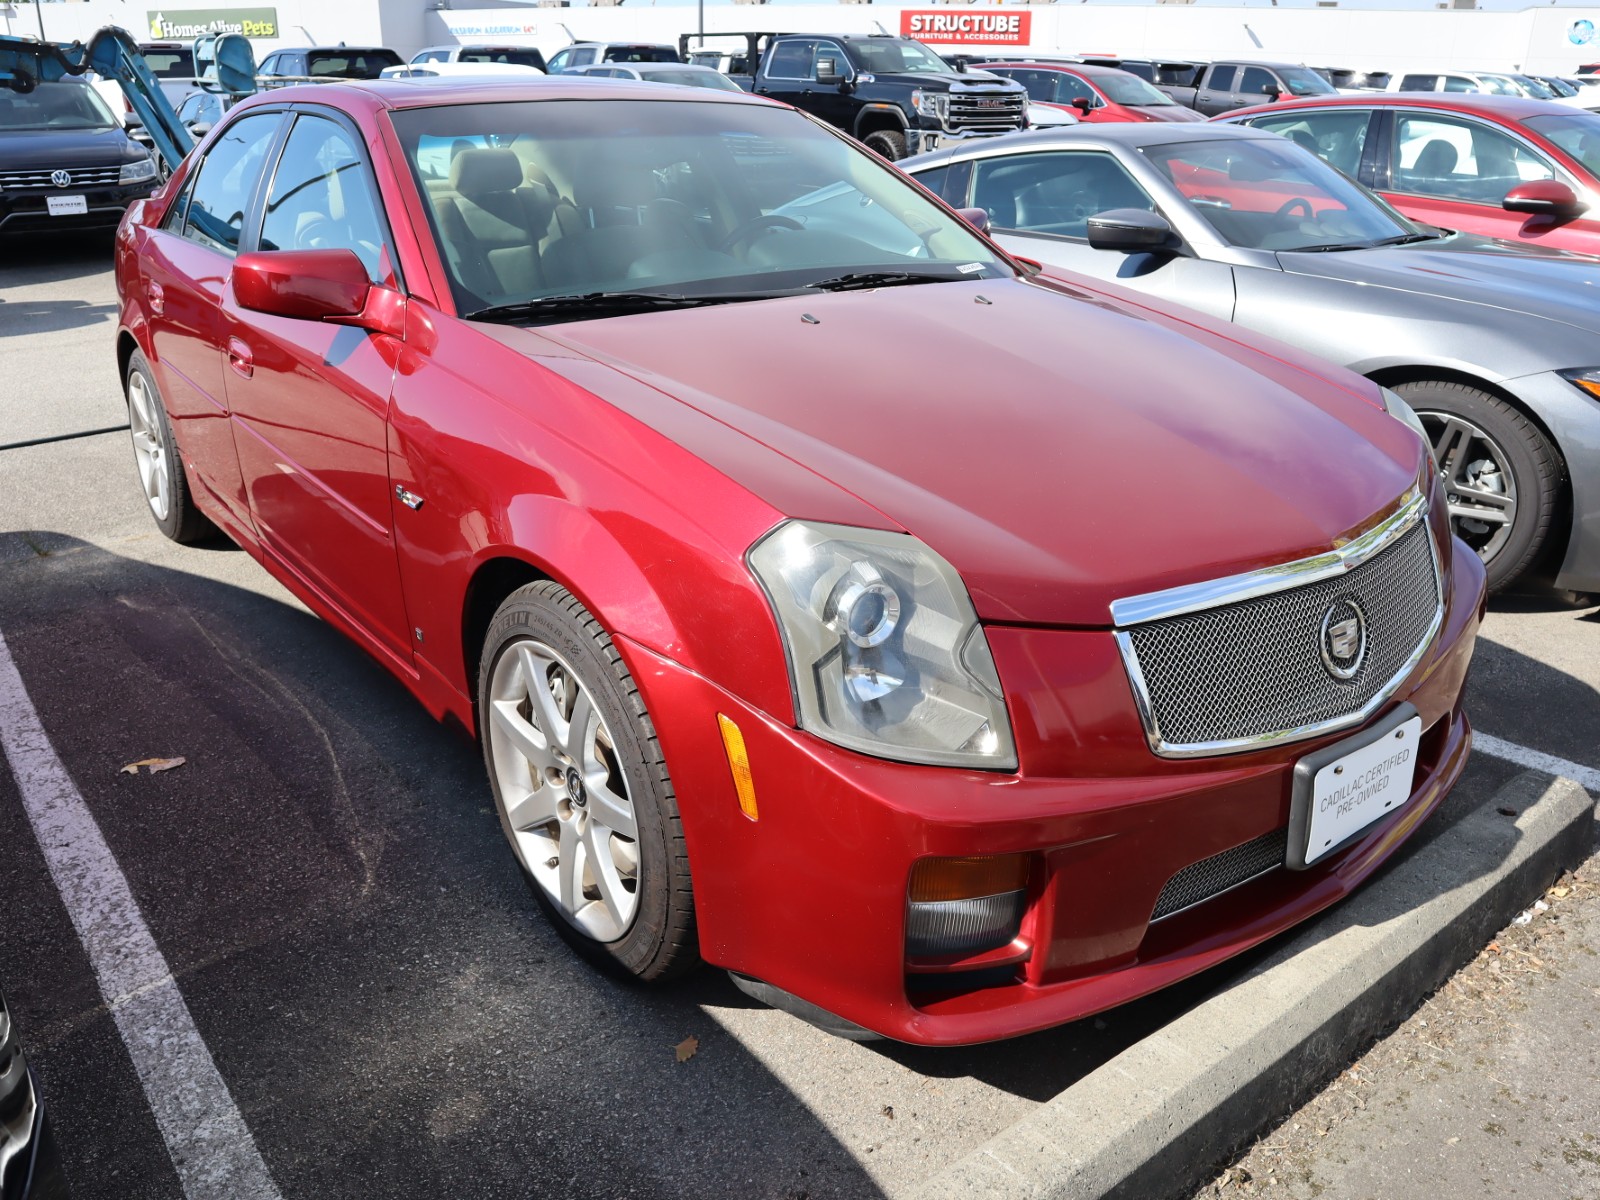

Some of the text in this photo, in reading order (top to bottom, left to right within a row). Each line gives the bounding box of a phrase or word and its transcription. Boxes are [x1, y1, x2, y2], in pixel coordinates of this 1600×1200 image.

[162, 22, 208, 37] Homes
[242, 20, 274, 36] Pets
[910, 15, 1020, 32] STRUCTUBE
[964, 33, 1019, 41] ACCESSORIES
[1320, 748, 1410, 813] CADILLAC CERTIFIED
[1336, 775, 1390, 819] PRE-OWNED
